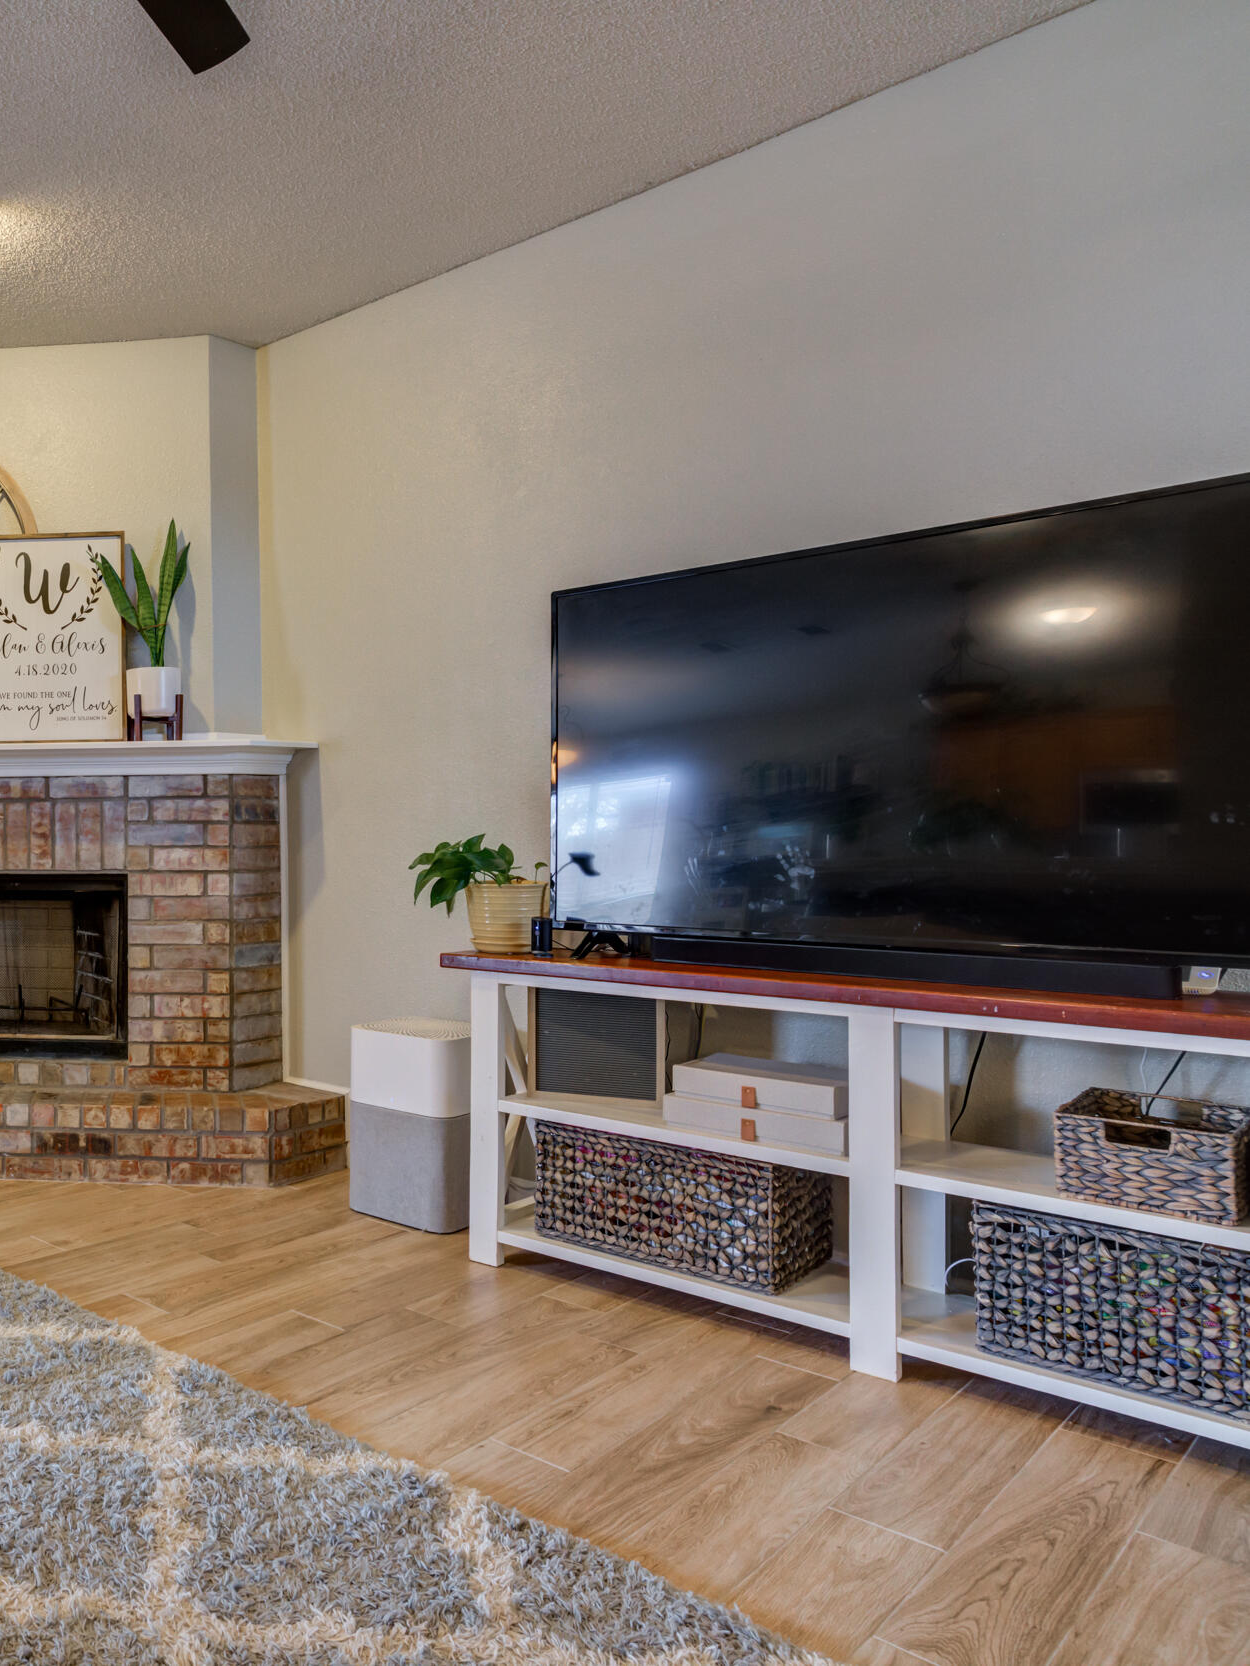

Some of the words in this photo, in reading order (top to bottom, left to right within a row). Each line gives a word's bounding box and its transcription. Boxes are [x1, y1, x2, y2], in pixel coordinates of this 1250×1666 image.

[51, 631, 106, 658] Alexis
[15, 664, 77, 676] 4.18.2020
[13, 691, 38, 699] FOUND
[40, 691, 55, 699] THE
[56, 690, 71, 698] ONE
[17, 704, 43, 730] my
[48, 686, 76, 714] soul
